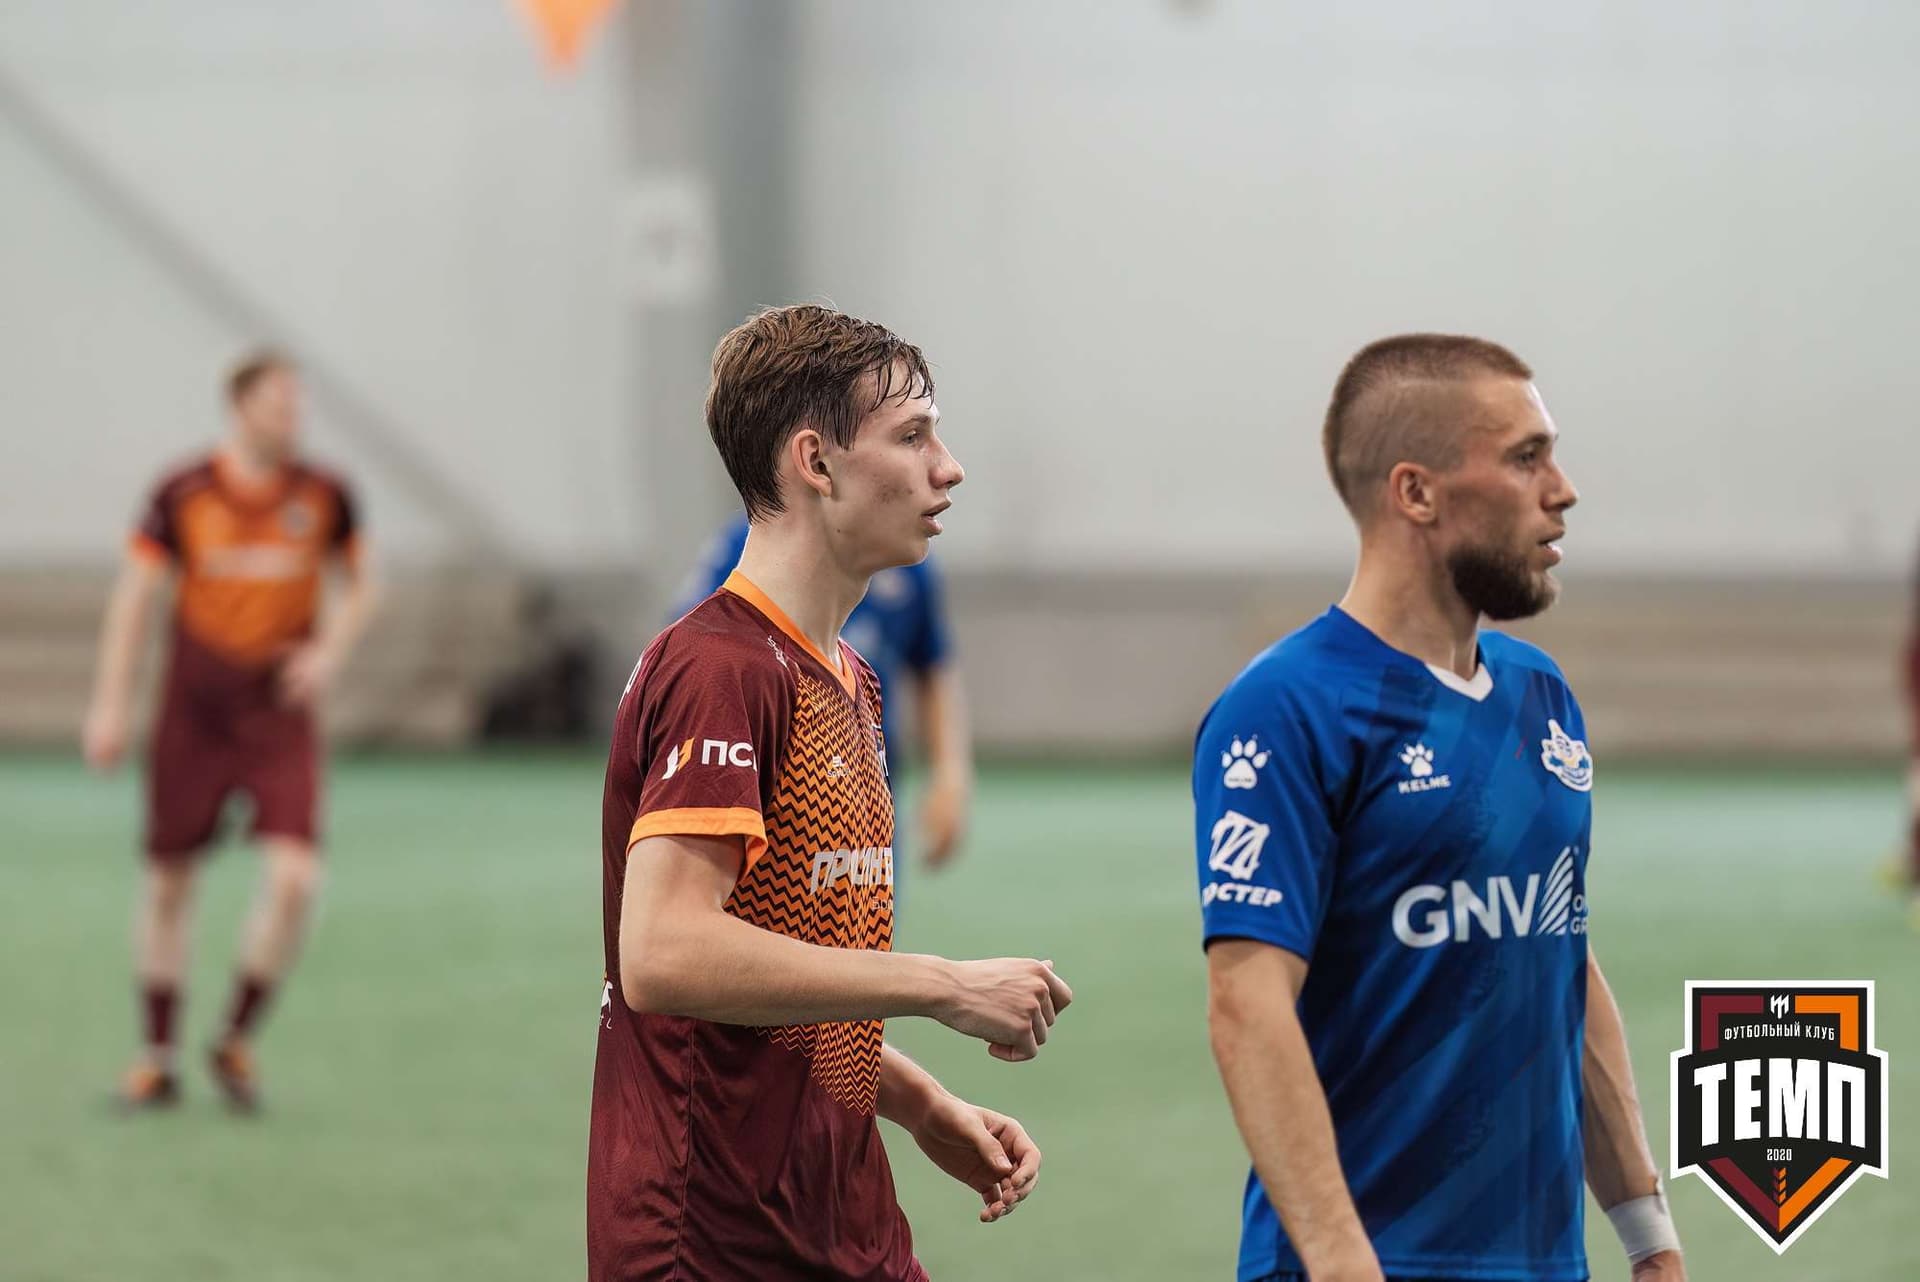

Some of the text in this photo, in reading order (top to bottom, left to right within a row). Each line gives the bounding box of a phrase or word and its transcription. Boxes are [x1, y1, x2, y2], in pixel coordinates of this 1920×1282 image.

[701, 738, 757, 771] ПС
[1398, 774, 1451, 794] KELME
[1392, 873, 1541, 948] GNV
